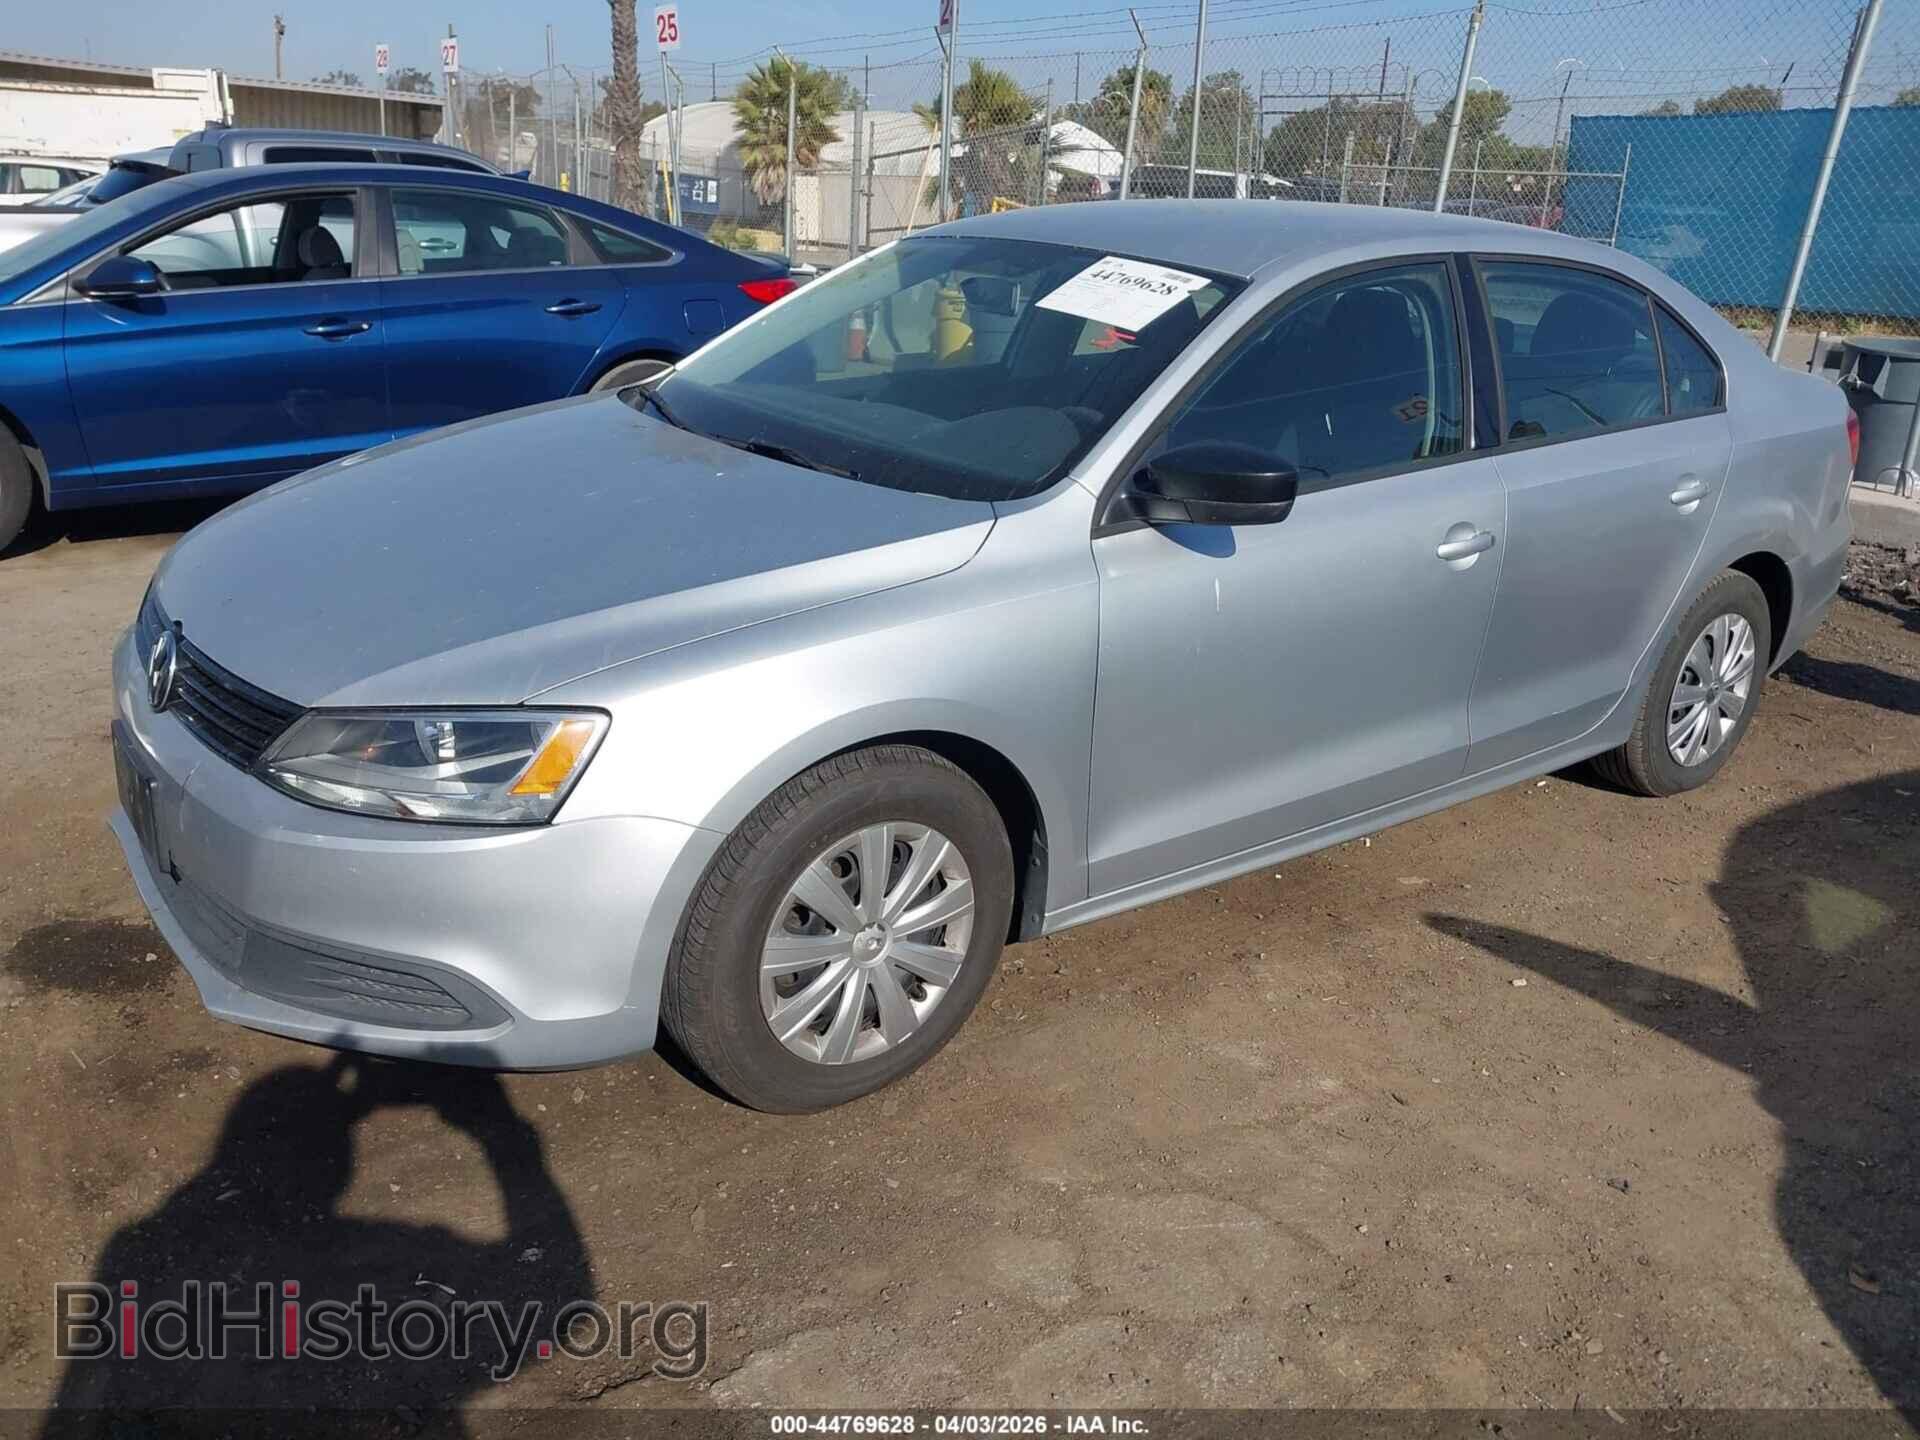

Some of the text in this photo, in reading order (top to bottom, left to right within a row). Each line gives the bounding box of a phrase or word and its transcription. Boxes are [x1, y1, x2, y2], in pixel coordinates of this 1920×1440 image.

[656, 13, 678, 43] 25
[442, 45, 457, 66] 27
[1091, 269, 1178, 296] 44769628
